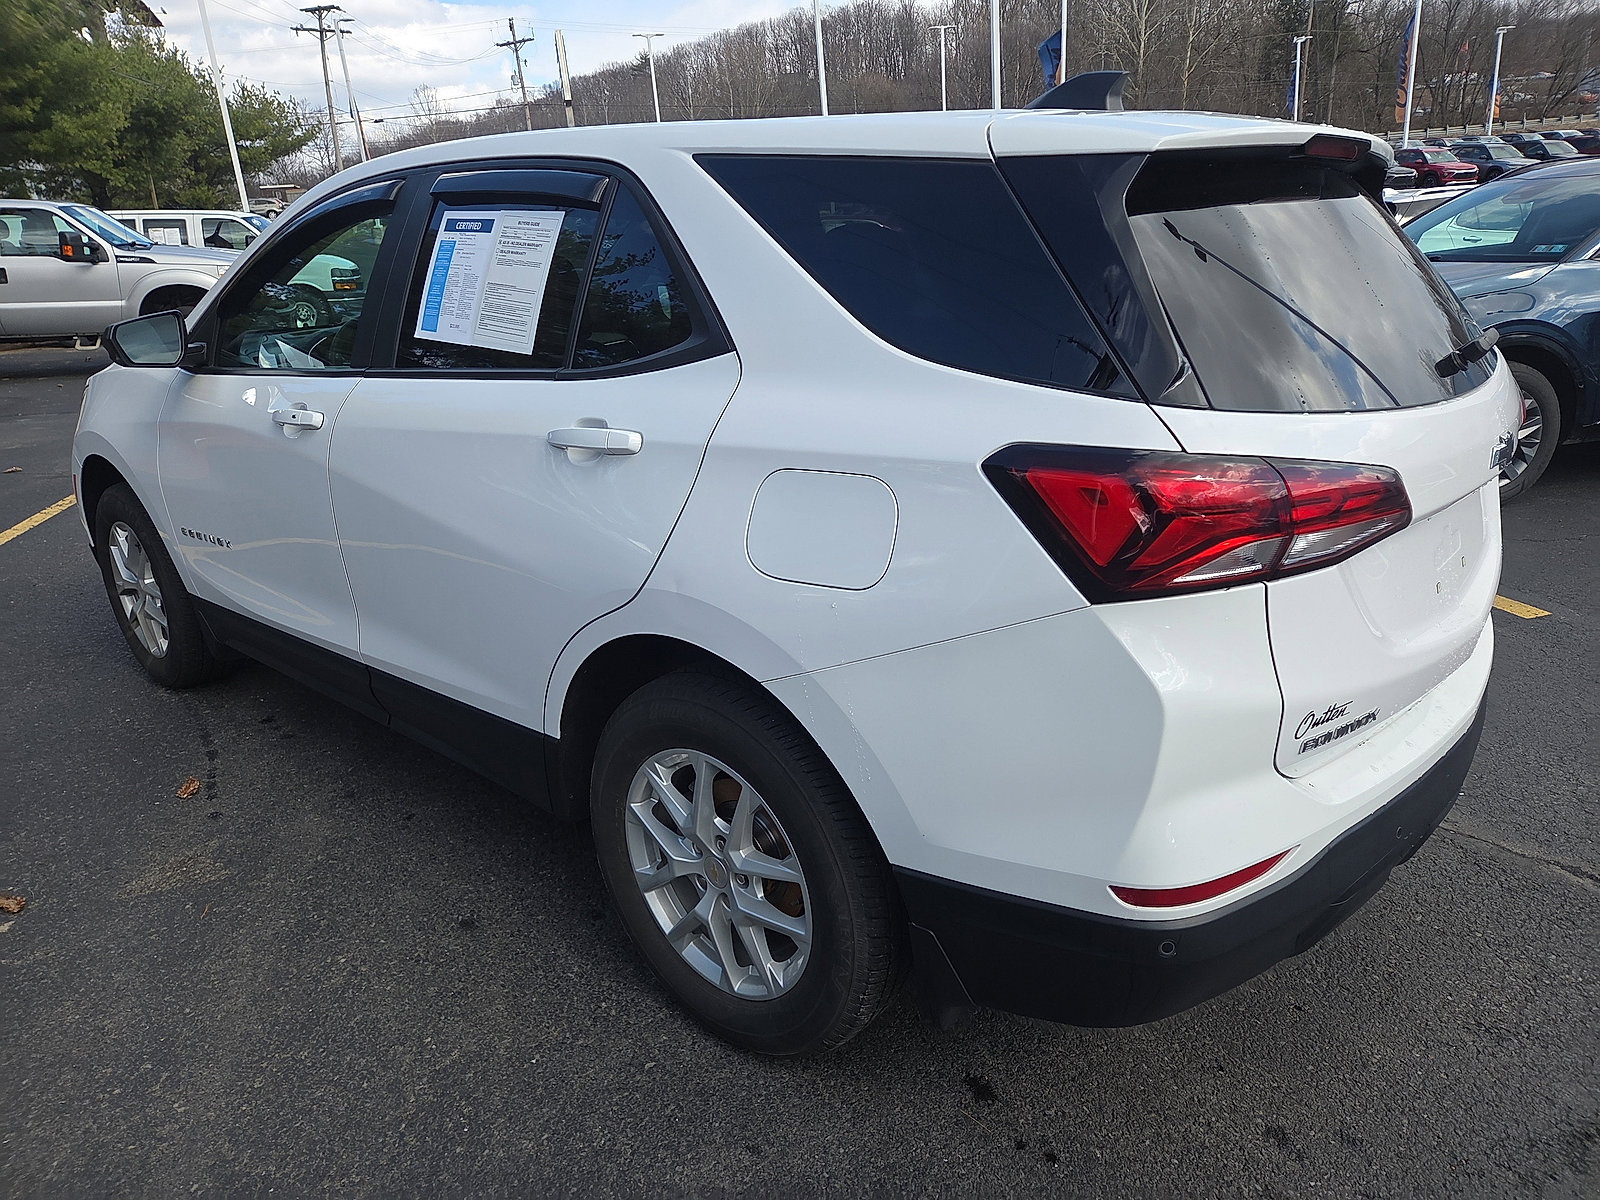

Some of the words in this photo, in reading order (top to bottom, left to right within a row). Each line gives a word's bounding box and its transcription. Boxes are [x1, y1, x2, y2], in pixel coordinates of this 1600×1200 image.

[455, 221, 482, 230] CERTIFIED
[1294, 700, 1354, 740] Outten
[1298, 707, 1381, 755] EQUINOX
